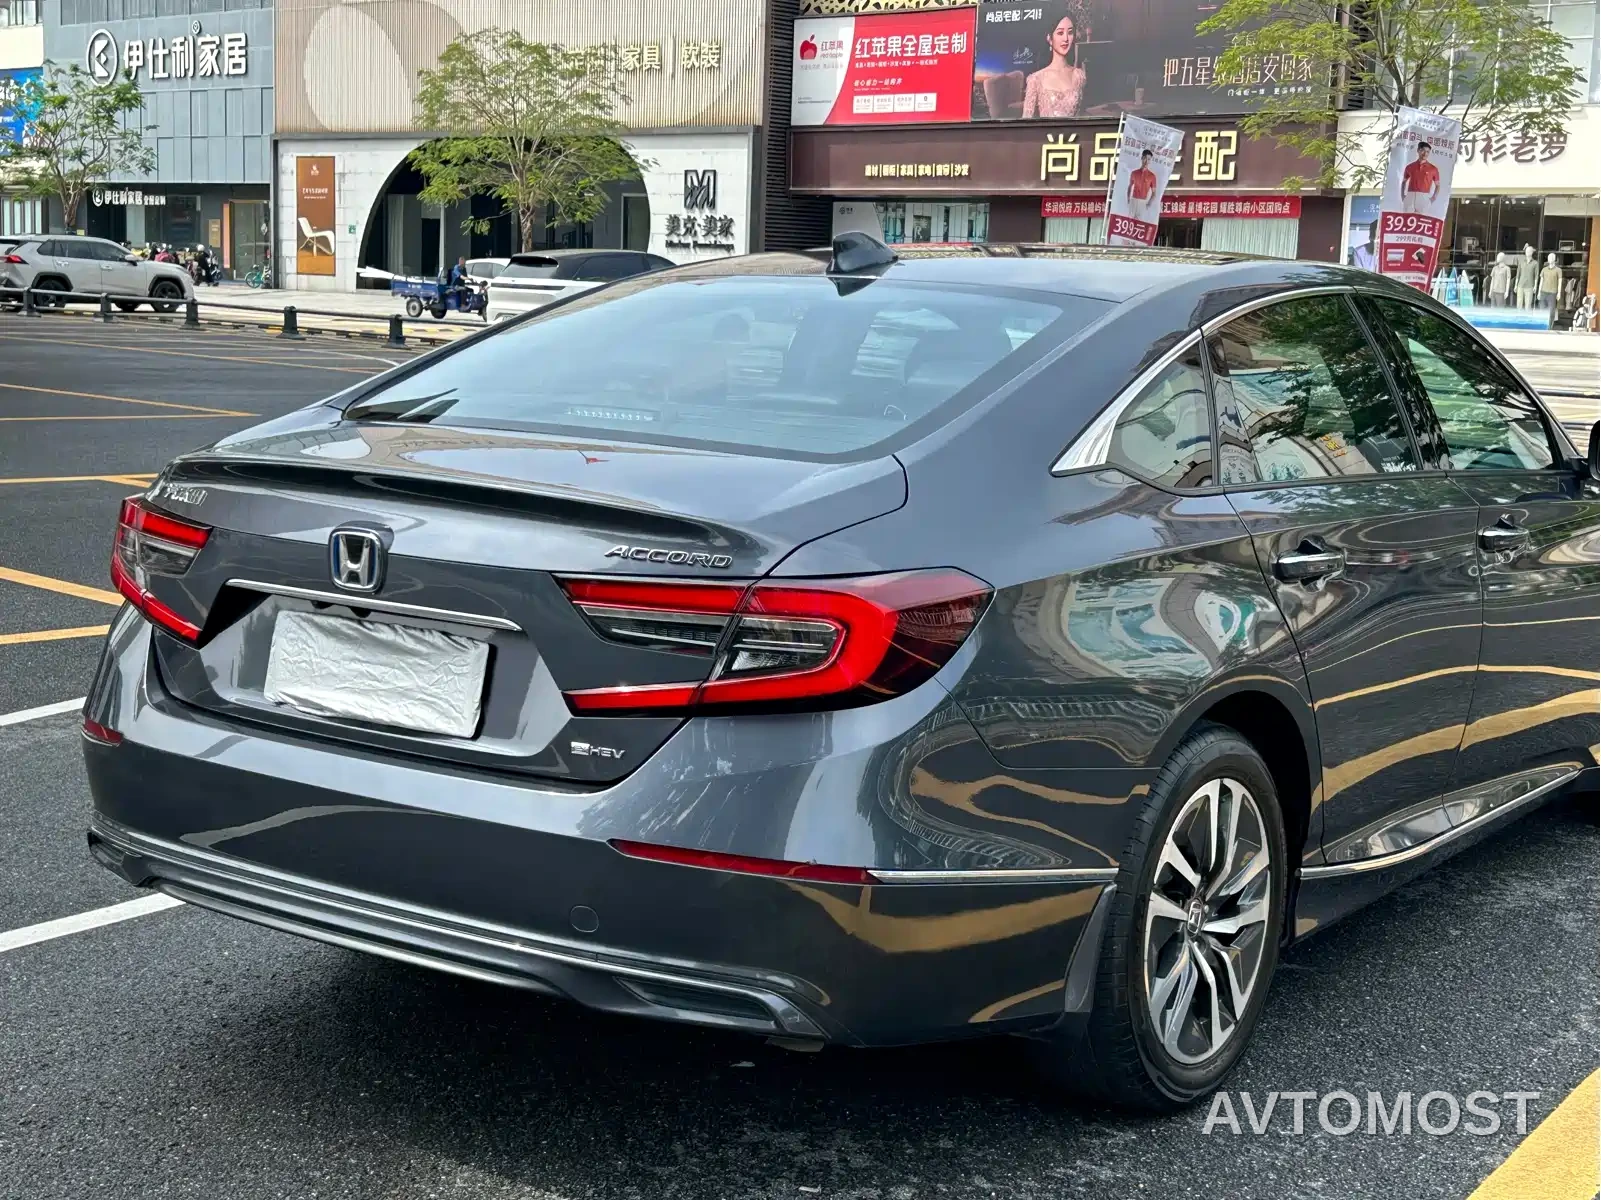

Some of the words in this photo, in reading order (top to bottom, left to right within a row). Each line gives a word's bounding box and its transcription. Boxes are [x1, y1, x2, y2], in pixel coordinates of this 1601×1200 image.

[986, 10, 1020, 22] 尚品宅配
[123, 32, 247, 80] 伊仕利家居
[623, 45, 661, 71] 家具
[682, 42, 720, 70] 软装
[855, 32, 967, 58] 红苹果全屋定制
[1041, 130, 1237, 181] 尚品配
[1386, 215, 1432, 235] 39.9元
[604, 544, 733, 569] ACCORD
